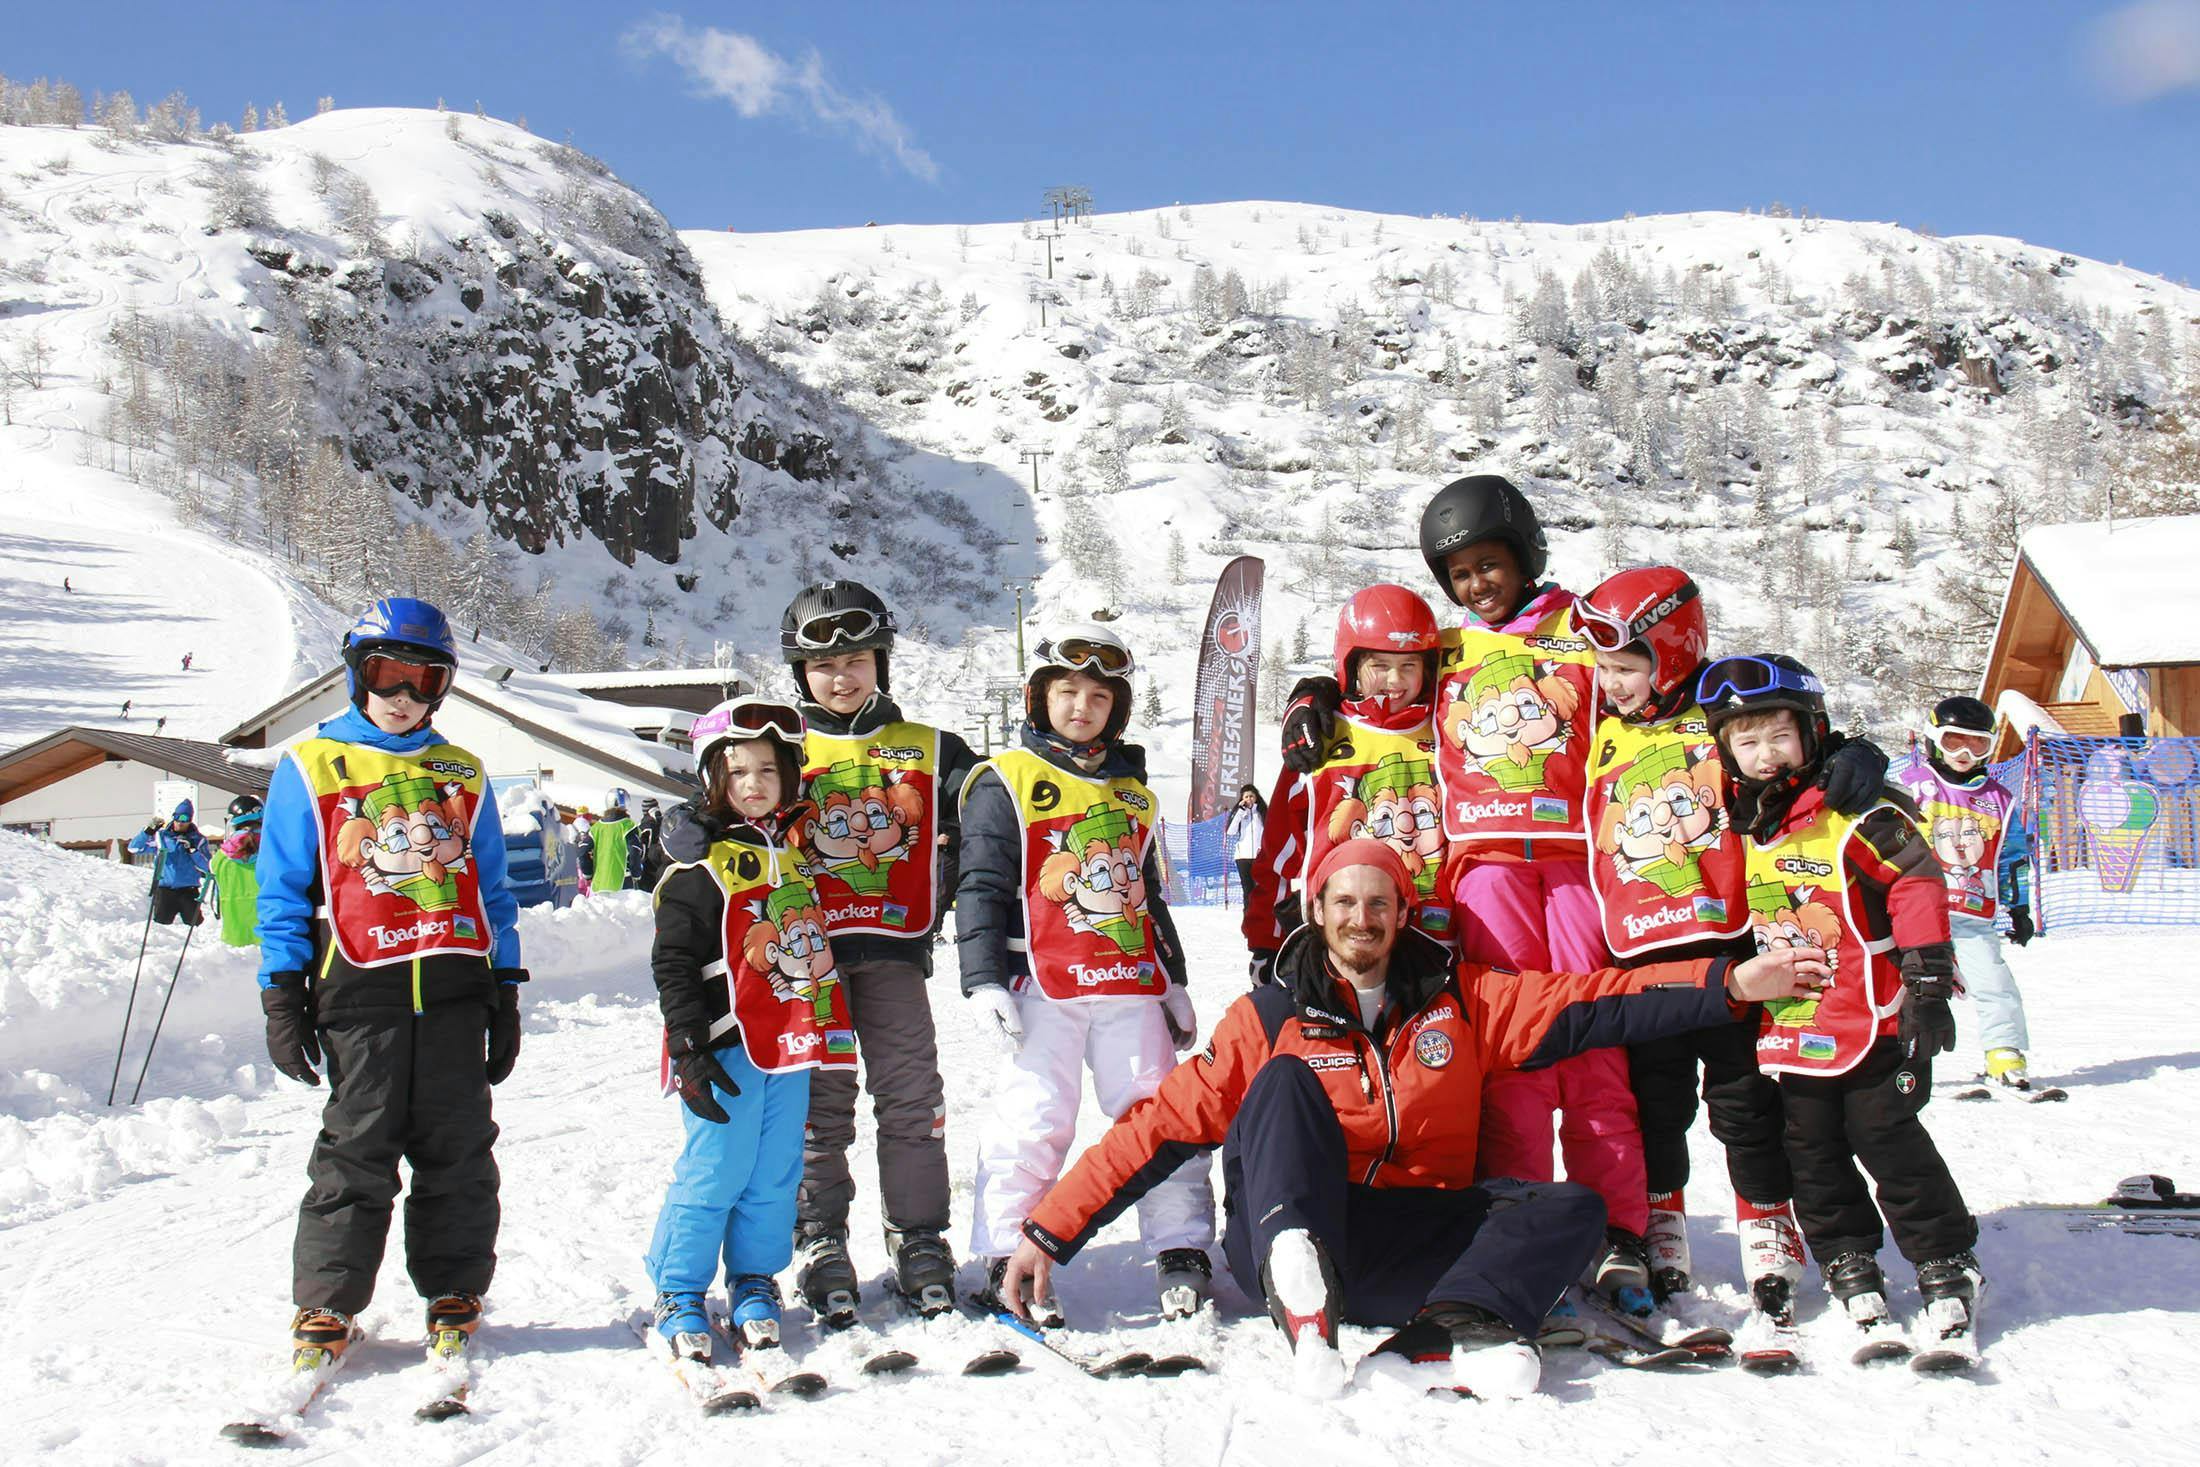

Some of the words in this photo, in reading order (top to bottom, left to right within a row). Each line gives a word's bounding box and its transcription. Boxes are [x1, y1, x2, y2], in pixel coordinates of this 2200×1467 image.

[1634, 592, 1684, 634] uvex
[1525, 637, 1587, 652] equipe
[1220, 658, 1247, 798] FREESKIERS
[1674, 722, 1707, 734] equ
[329, 754, 351, 780] 1
[1031, 780, 1061, 813] 9
[1456, 799, 1528, 823] Loacker
[368, 919, 449, 950] Loacker
[1622, 905, 1693, 939] Loacker
[1067, 961, 1139, 986] Loacke
[1412, 1006, 1454, 1033] COLMAR
[1308, 1057, 1358, 1069] quipe
